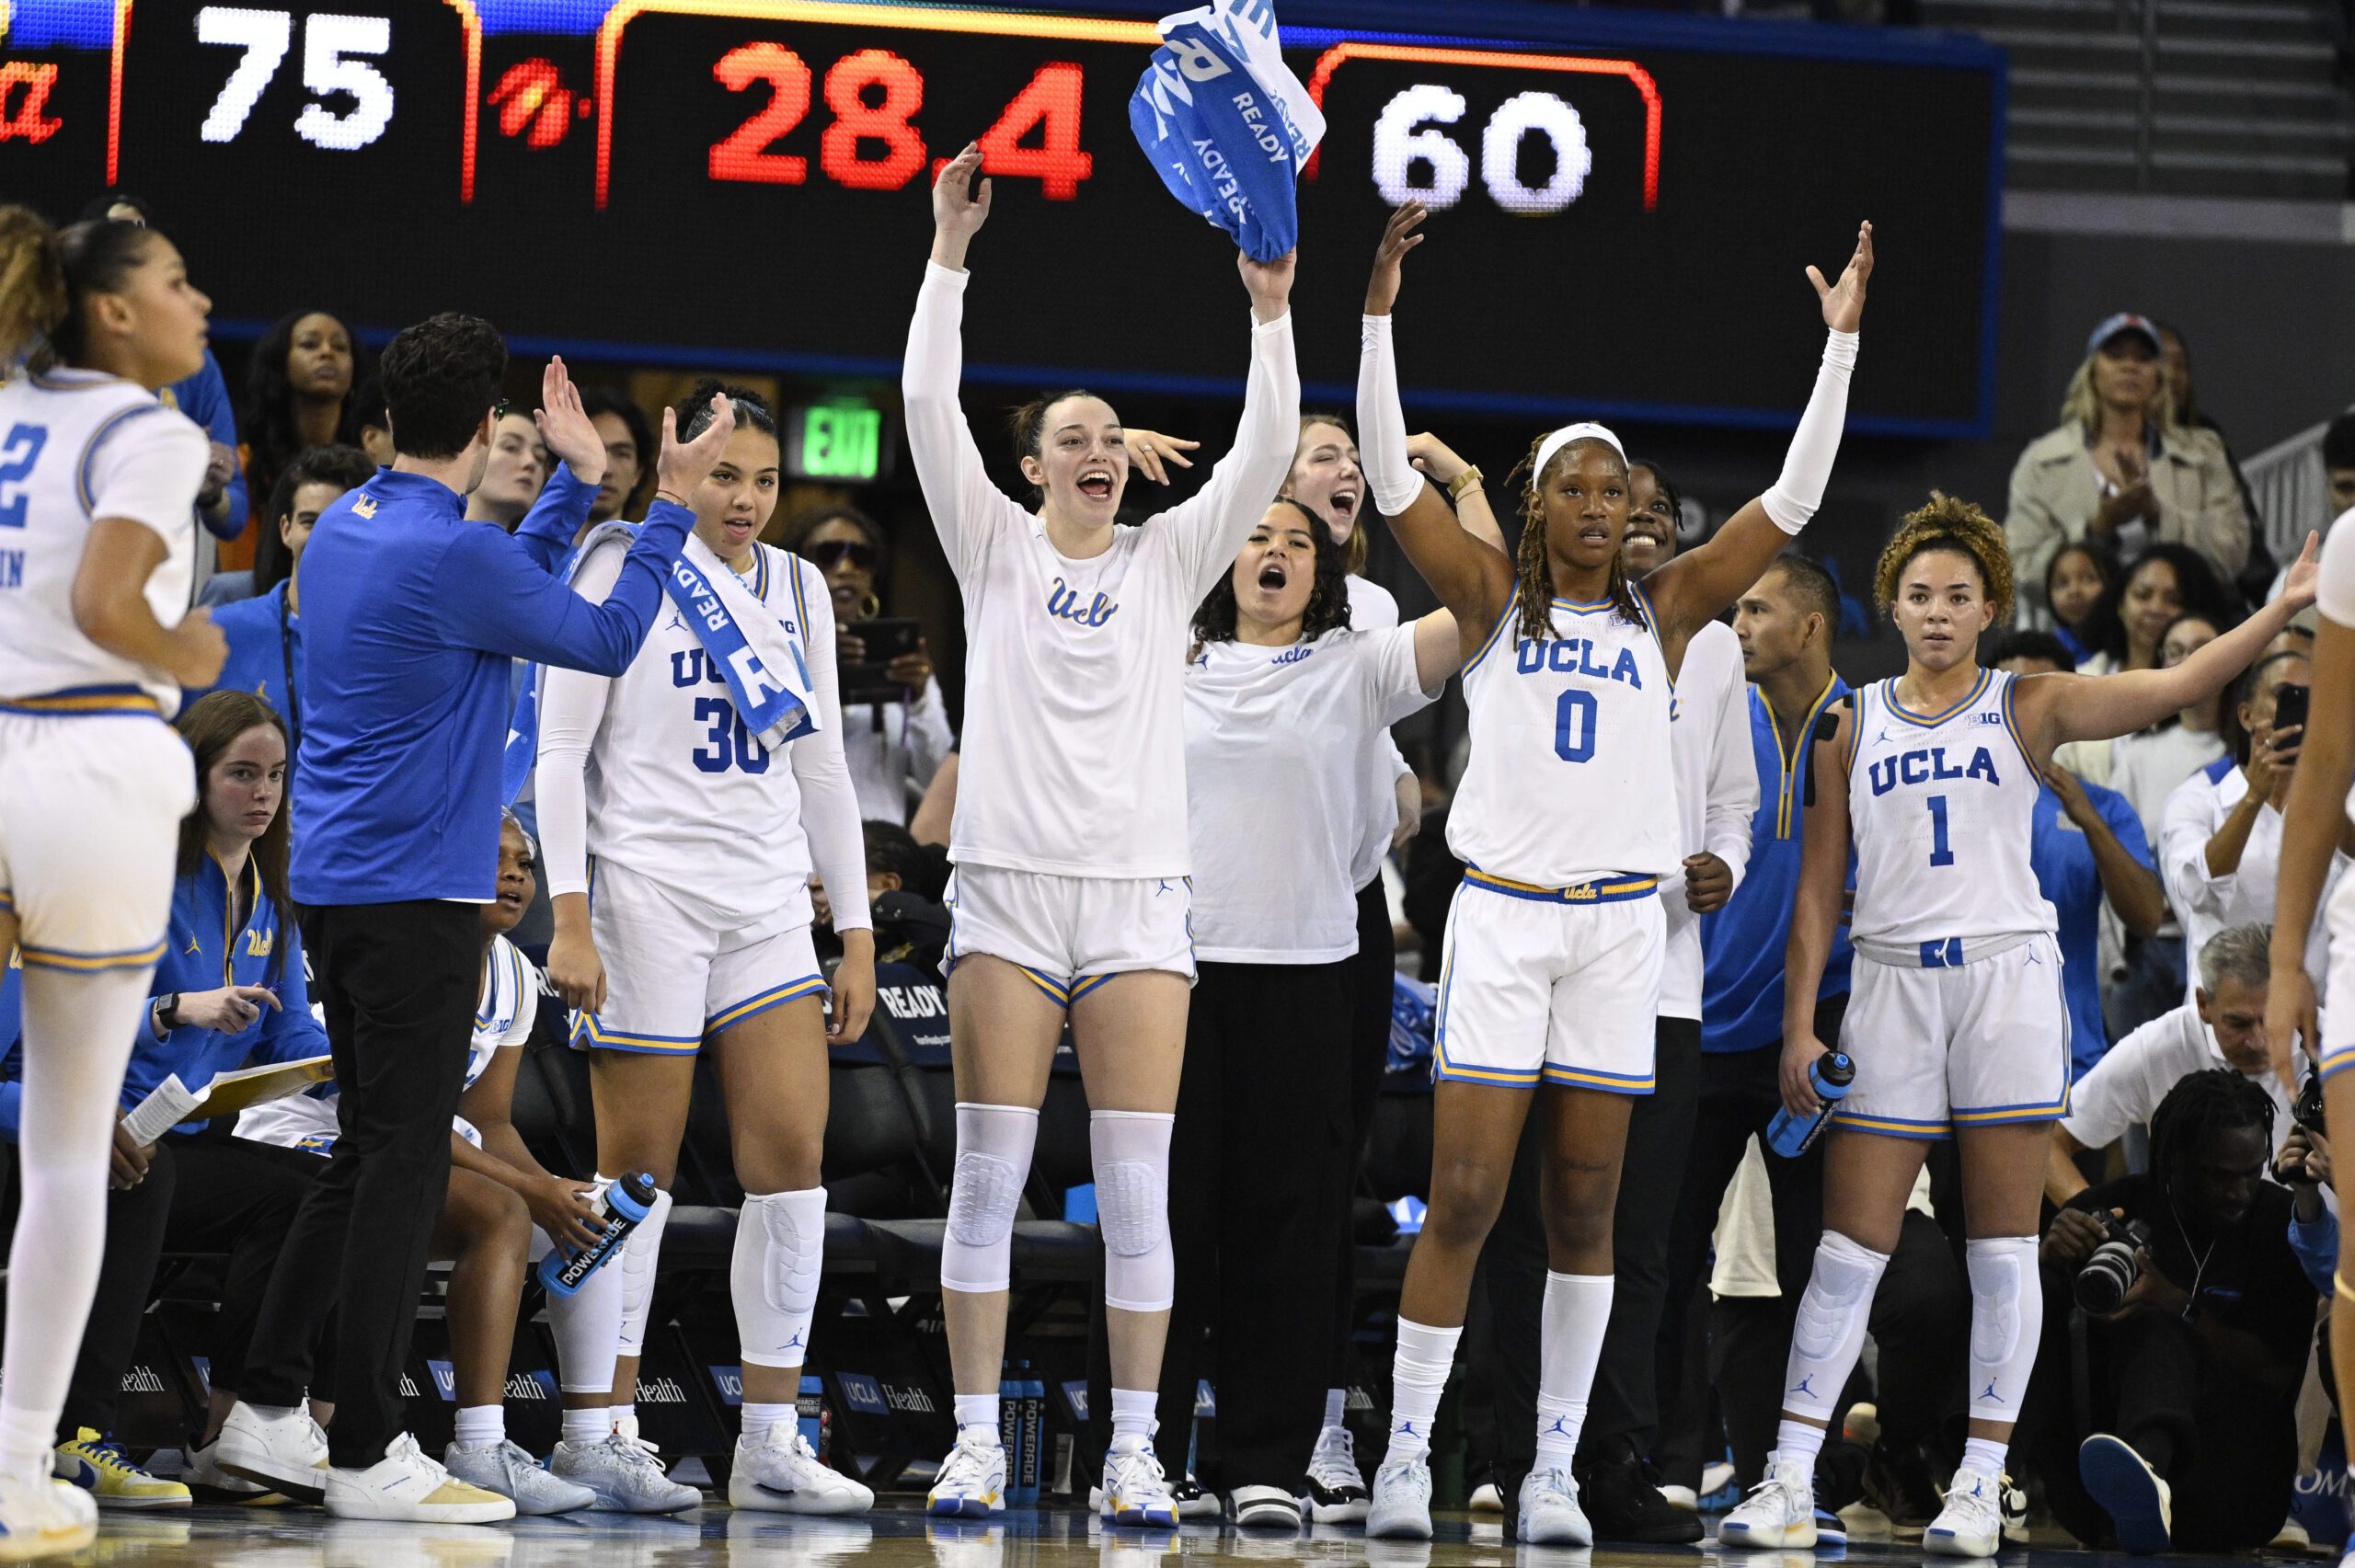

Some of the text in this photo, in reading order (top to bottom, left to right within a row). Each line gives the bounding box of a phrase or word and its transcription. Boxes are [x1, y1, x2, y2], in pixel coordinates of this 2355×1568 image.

[194, 7, 394, 150] 75
[1232, 92, 1290, 163] READY
[1373, 85, 1591, 212] 60
[0, 423, 48, 528] 2
[672, 560, 729, 632] READY
[1517, 638, 1641, 691] UCLA
[1555, 689, 1597, 763] 0
[1868, 746, 2000, 797] UCLA
[1927, 795, 1954, 867] 1
[1564, 883, 1598, 900] Ucla
[878, 985, 947, 1018] READY
[120, 1366, 165, 1392] ealth
[503, 1374, 546, 1400] ealth
[846, 1381, 936, 1413] UCLA Health
[1024, 1400, 1038, 1484] POWERADE
